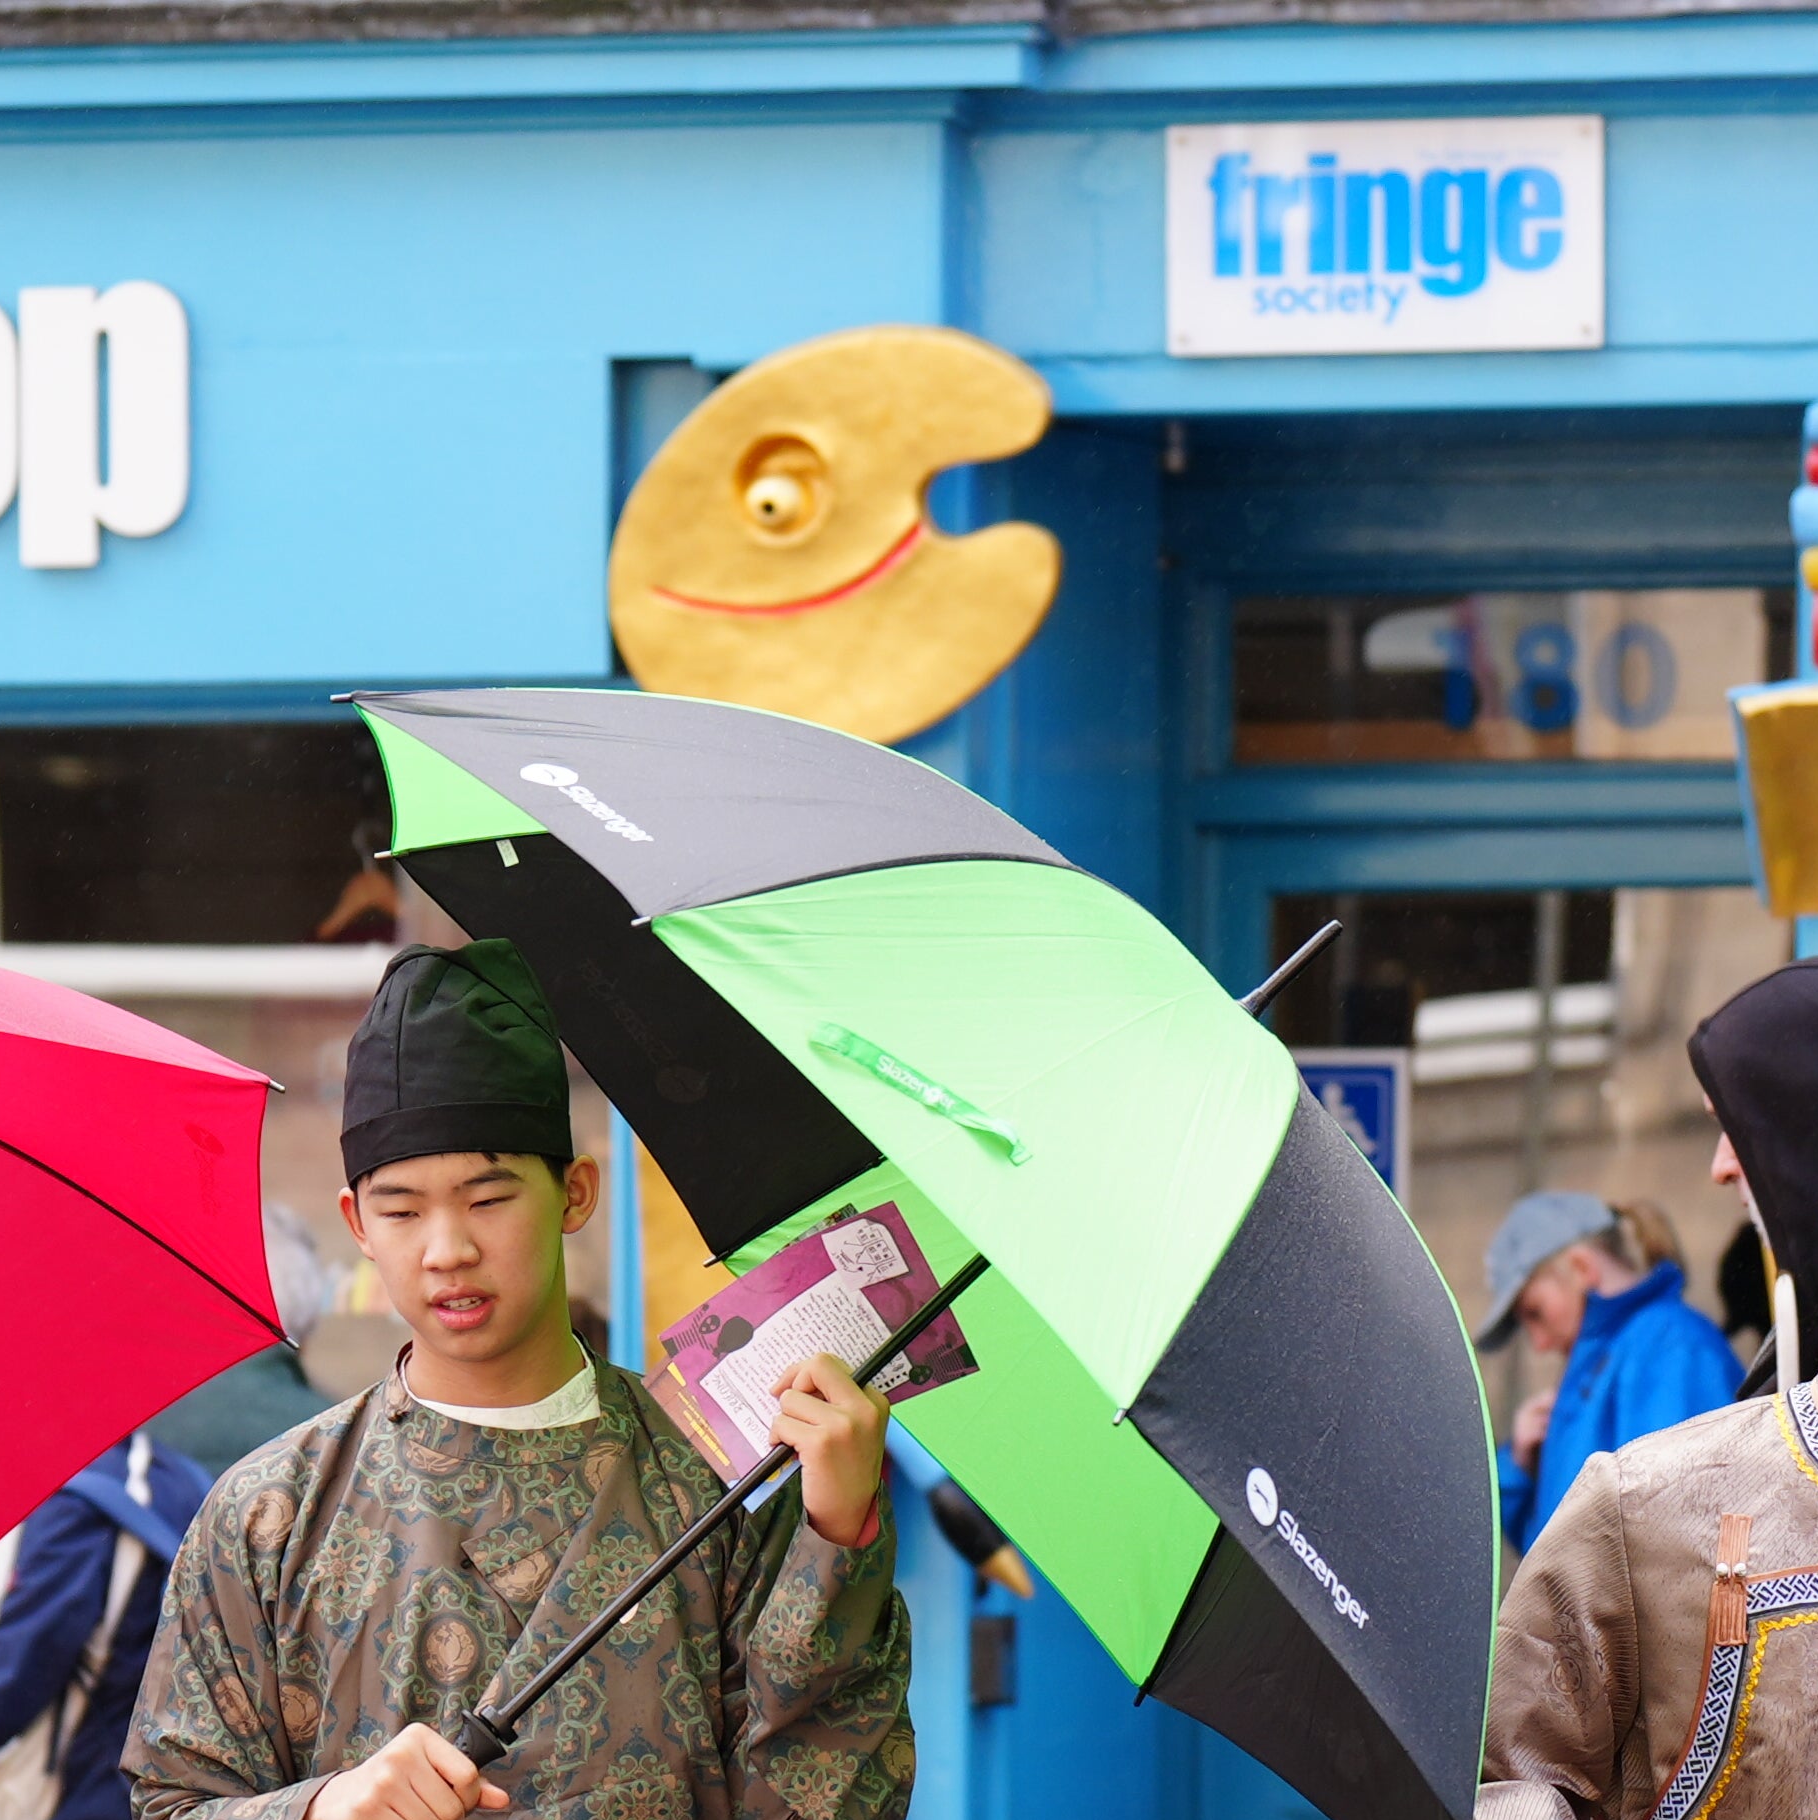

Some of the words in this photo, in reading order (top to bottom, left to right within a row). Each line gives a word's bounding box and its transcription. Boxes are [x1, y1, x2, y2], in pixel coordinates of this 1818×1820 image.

[1209, 152, 1563, 298] fringe
[1253, 276, 1410, 324] society
[1428, 618, 1679, 736] 180
[558, 785, 654, 841] Slazenger
[876, 1054, 956, 1110] Slazenger
[1276, 1510, 1370, 1630] Slazenger
